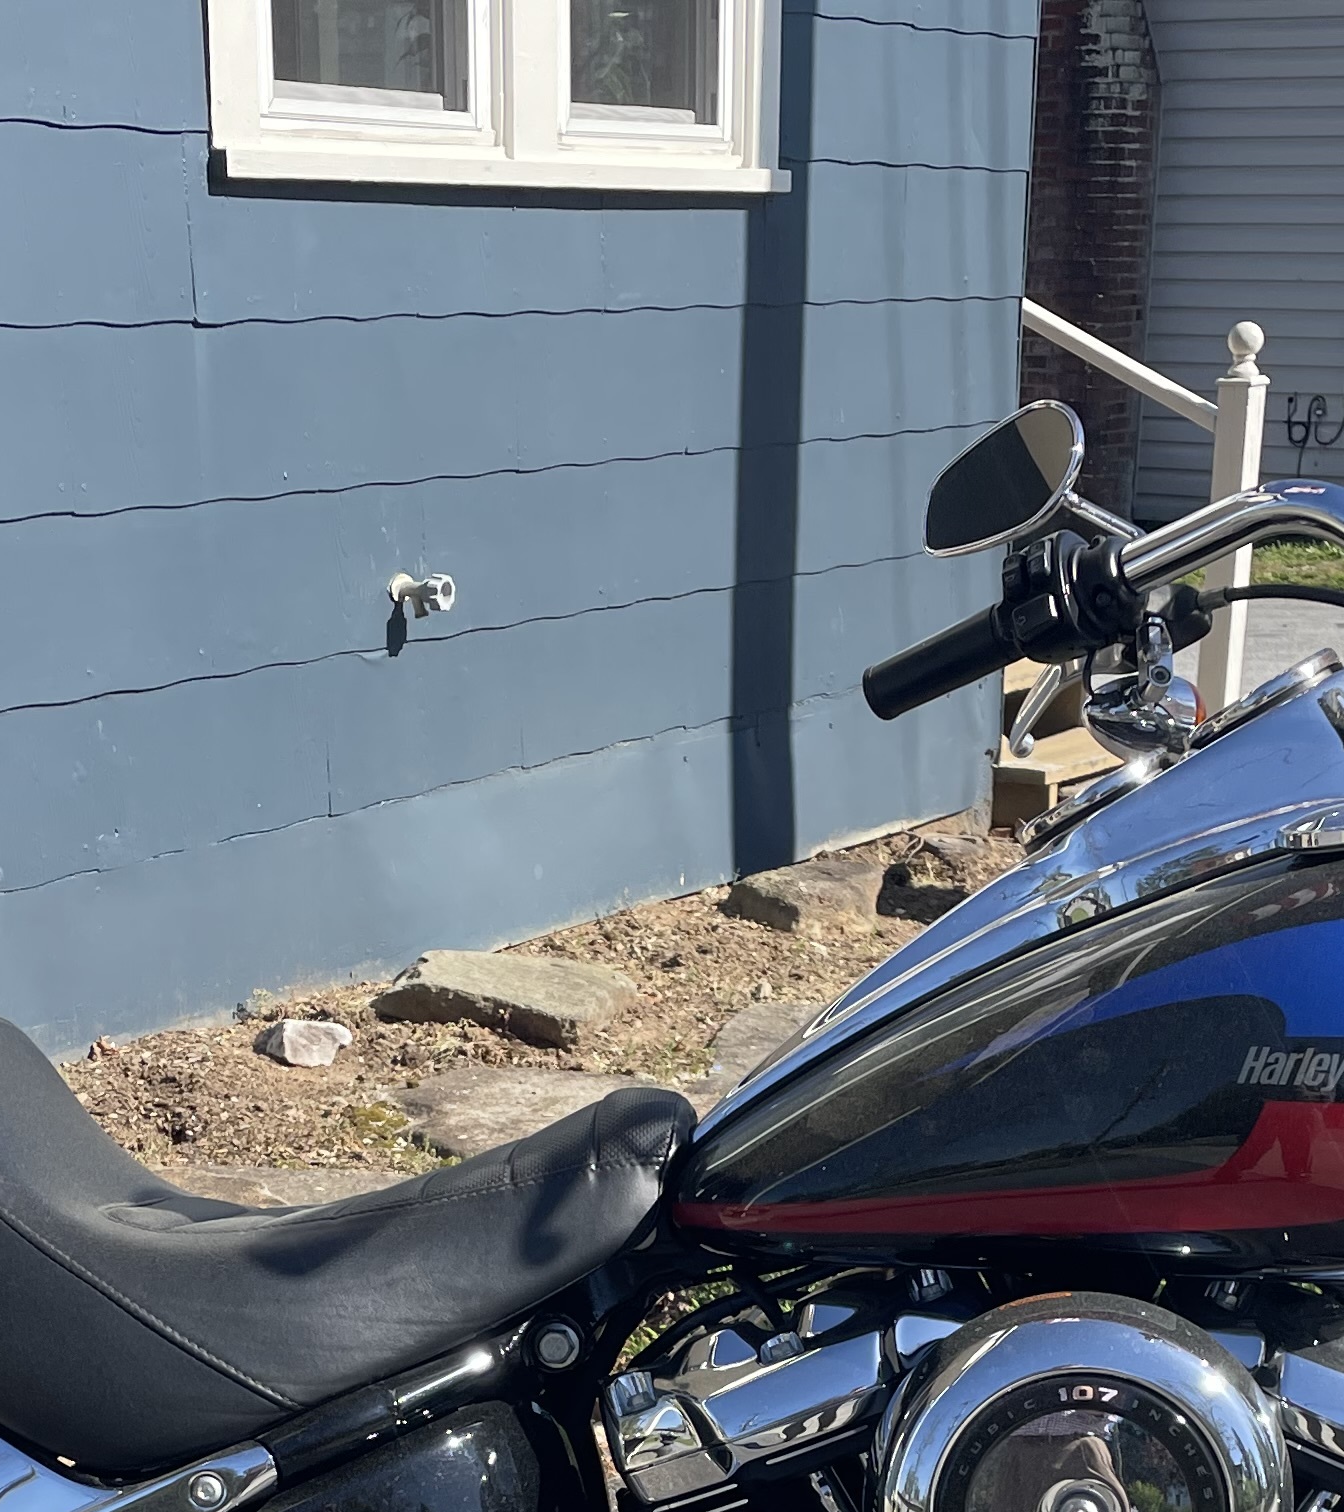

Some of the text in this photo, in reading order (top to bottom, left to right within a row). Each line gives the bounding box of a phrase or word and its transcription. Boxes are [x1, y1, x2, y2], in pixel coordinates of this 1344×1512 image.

[1057, 1385, 1119, 1403] 107
[957, 1399, 1215, 1501] CUBIC INCHES
